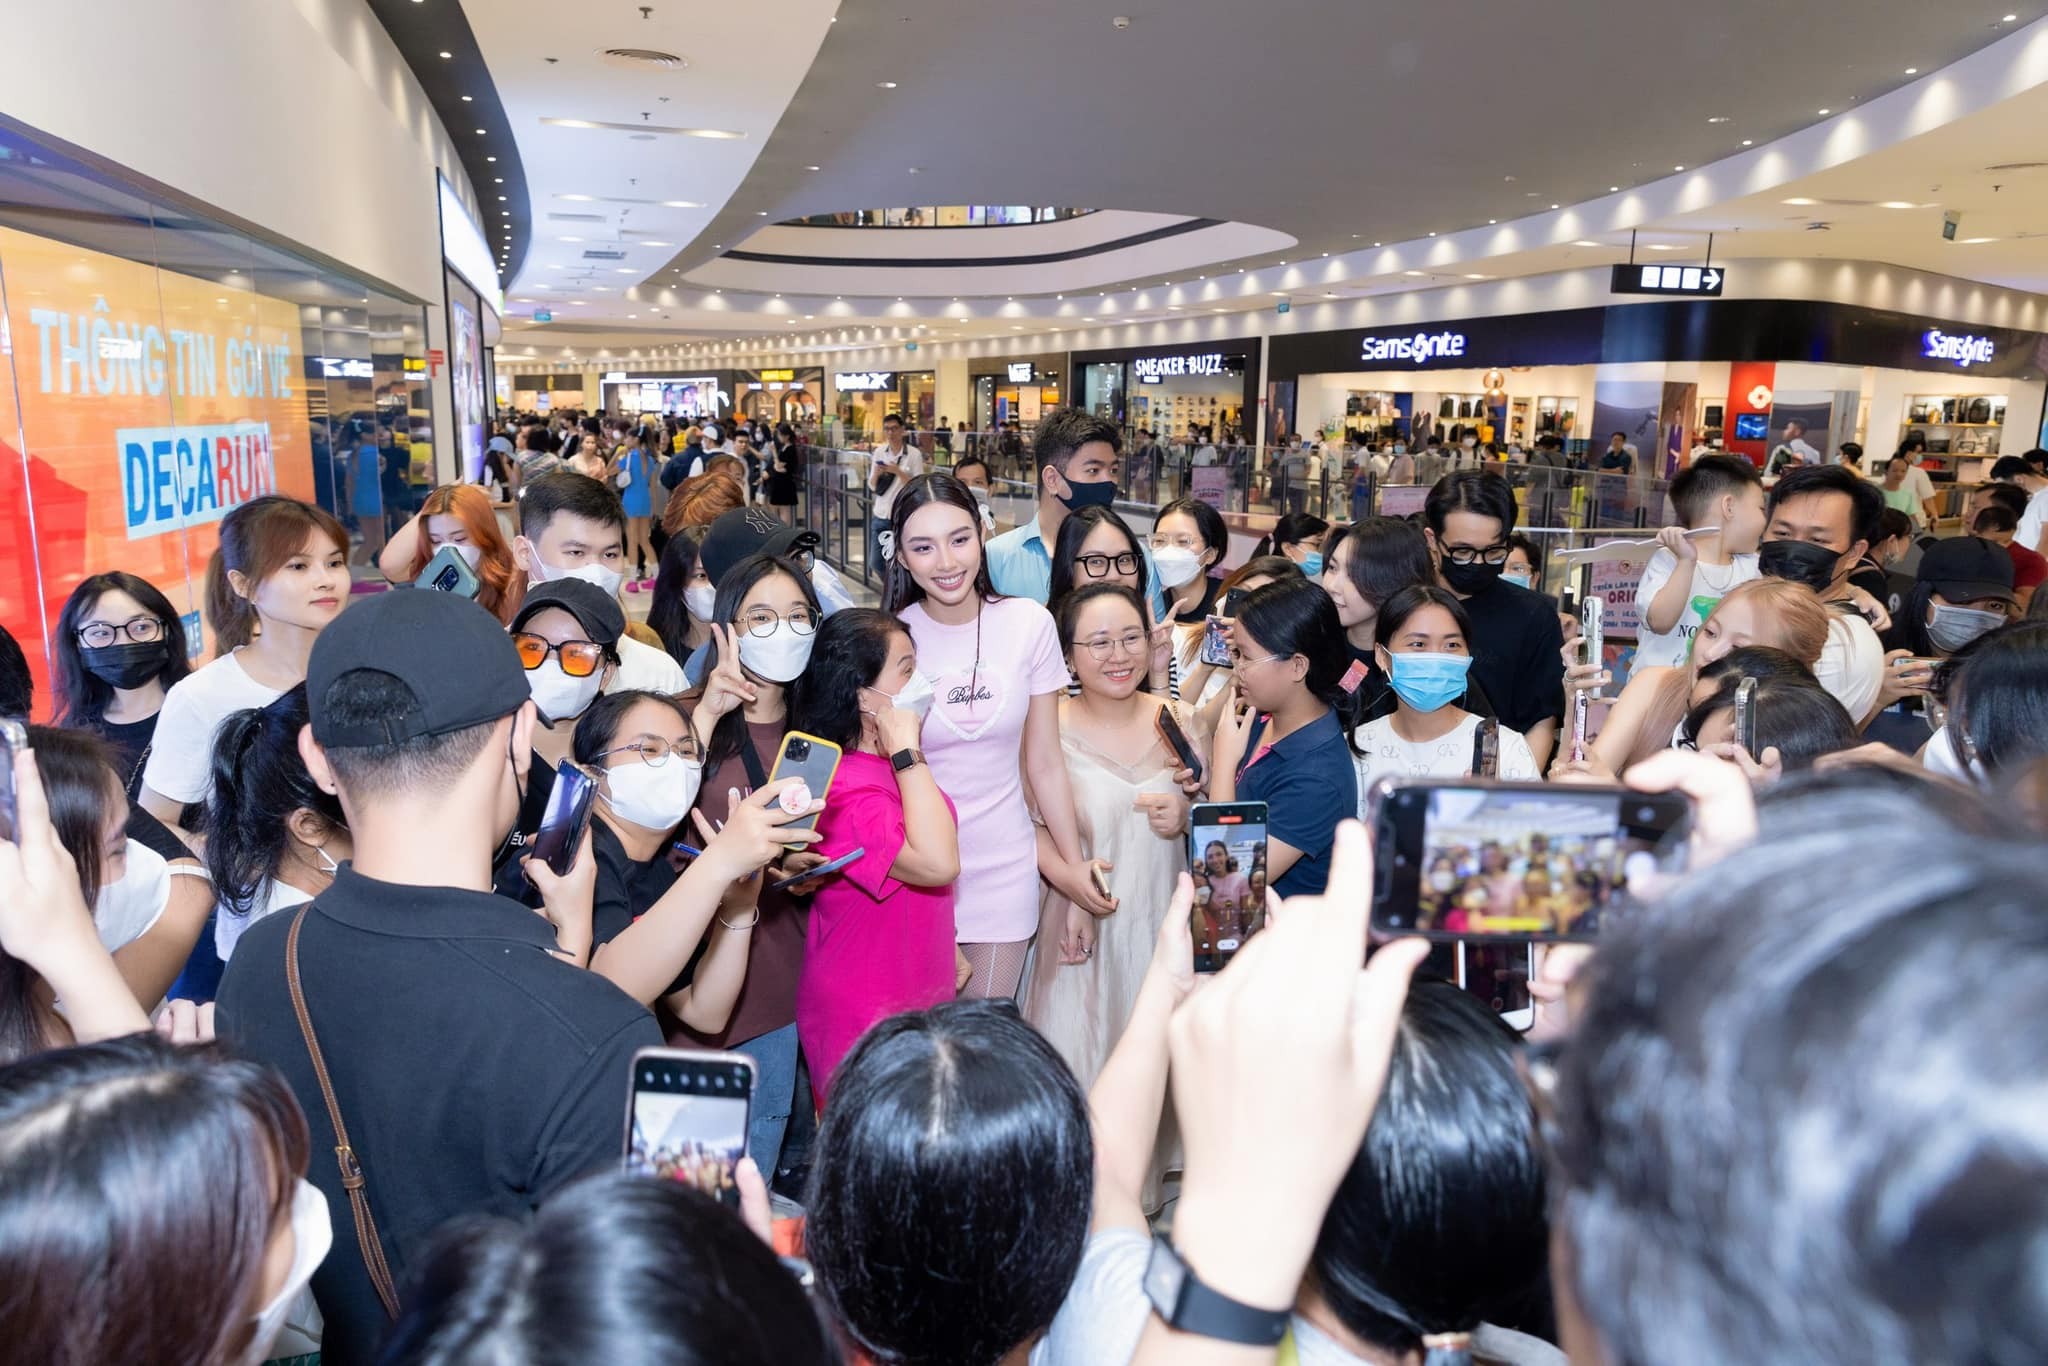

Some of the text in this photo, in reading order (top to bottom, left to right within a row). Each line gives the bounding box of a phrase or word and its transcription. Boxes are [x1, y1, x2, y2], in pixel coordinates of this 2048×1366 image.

[30, 297, 293, 399] THÔNG TIN GÓI VÉ
[1135, 354, 1222, 376] SNEAKER BUZZ
[1361, 331, 1465, 363] Samsonite
[125, 434, 272, 528] DECARUN
